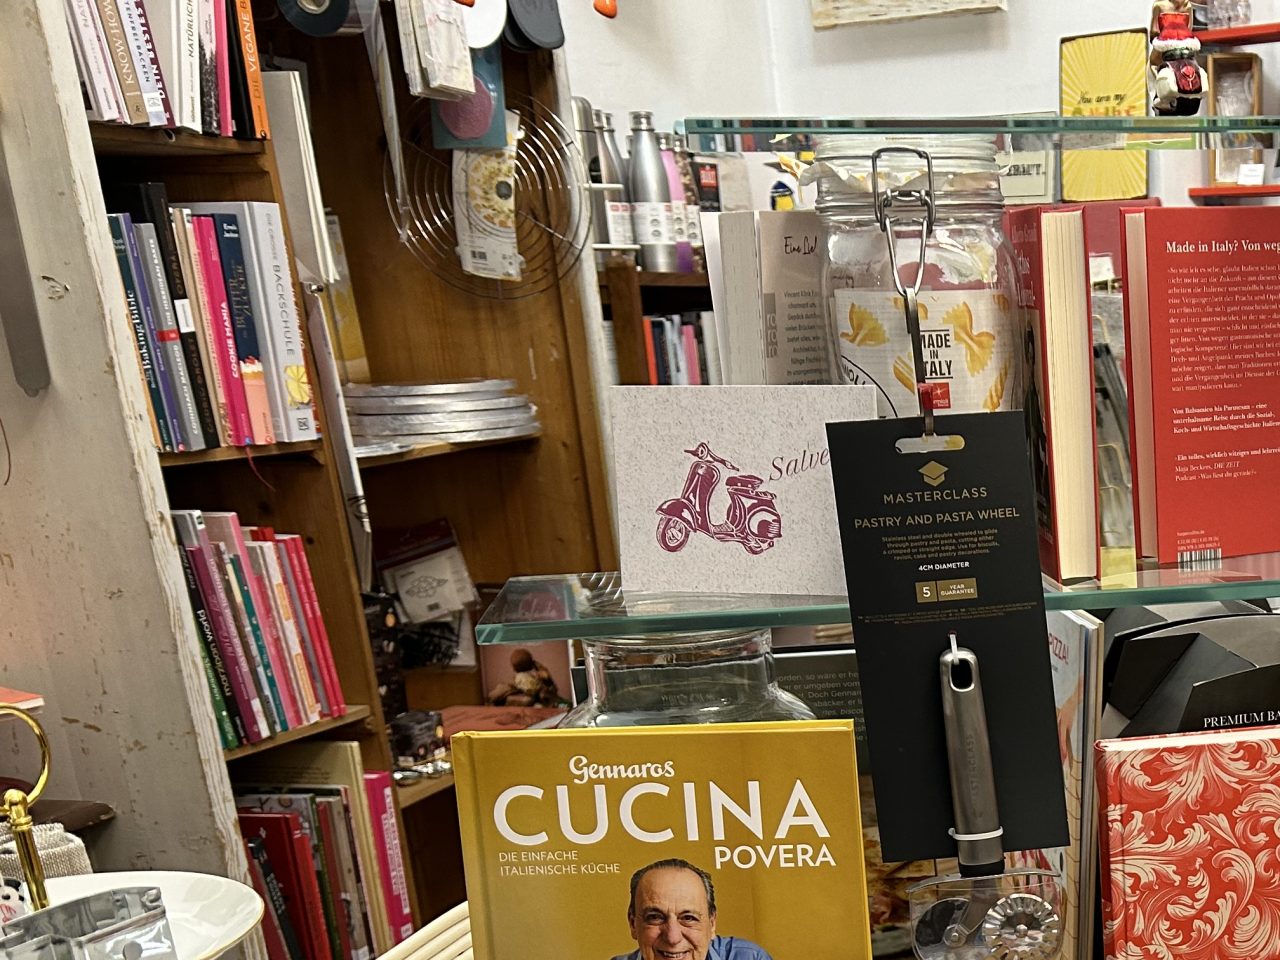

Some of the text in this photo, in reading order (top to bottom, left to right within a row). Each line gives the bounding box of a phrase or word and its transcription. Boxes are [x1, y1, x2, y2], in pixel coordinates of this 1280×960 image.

[243, 13, 256, 72] VEGANE
[112, 37, 135, 85] KNOW
[151, 63, 166, 99] DEIN
[1166, 241, 1195, 253] Made
[1198, 241, 1209, 252] in
[1211, 240, 1239, 255] Italy?
[1241, 240, 1261, 251] Von
[272, 264, 295, 356] BACKSCHULE
[220, 302, 241, 379] COOKIE MANIA
[768, 447, 830, 482] Salve
[883, 487, 988, 505] MASTERCLASS
[854, 507, 1020, 529] PASTRY AND PASTA WHEEL
[935, 562, 970, 570] DIAMETER
[922, 586, 931, 598] 5
[940, 588, 975, 596] GUARANTEE
[1203, 712, 1265, 728] PREMIUM
[568, 755, 676, 784] Gennaros
[493, 778, 832, 846] CUCINA
[499, 851, 579, 862] DIE EINFACHE
[714, 843, 837, 870] POVERA
[500, 862, 621, 877] ITALIENISCHE KÜCHE
